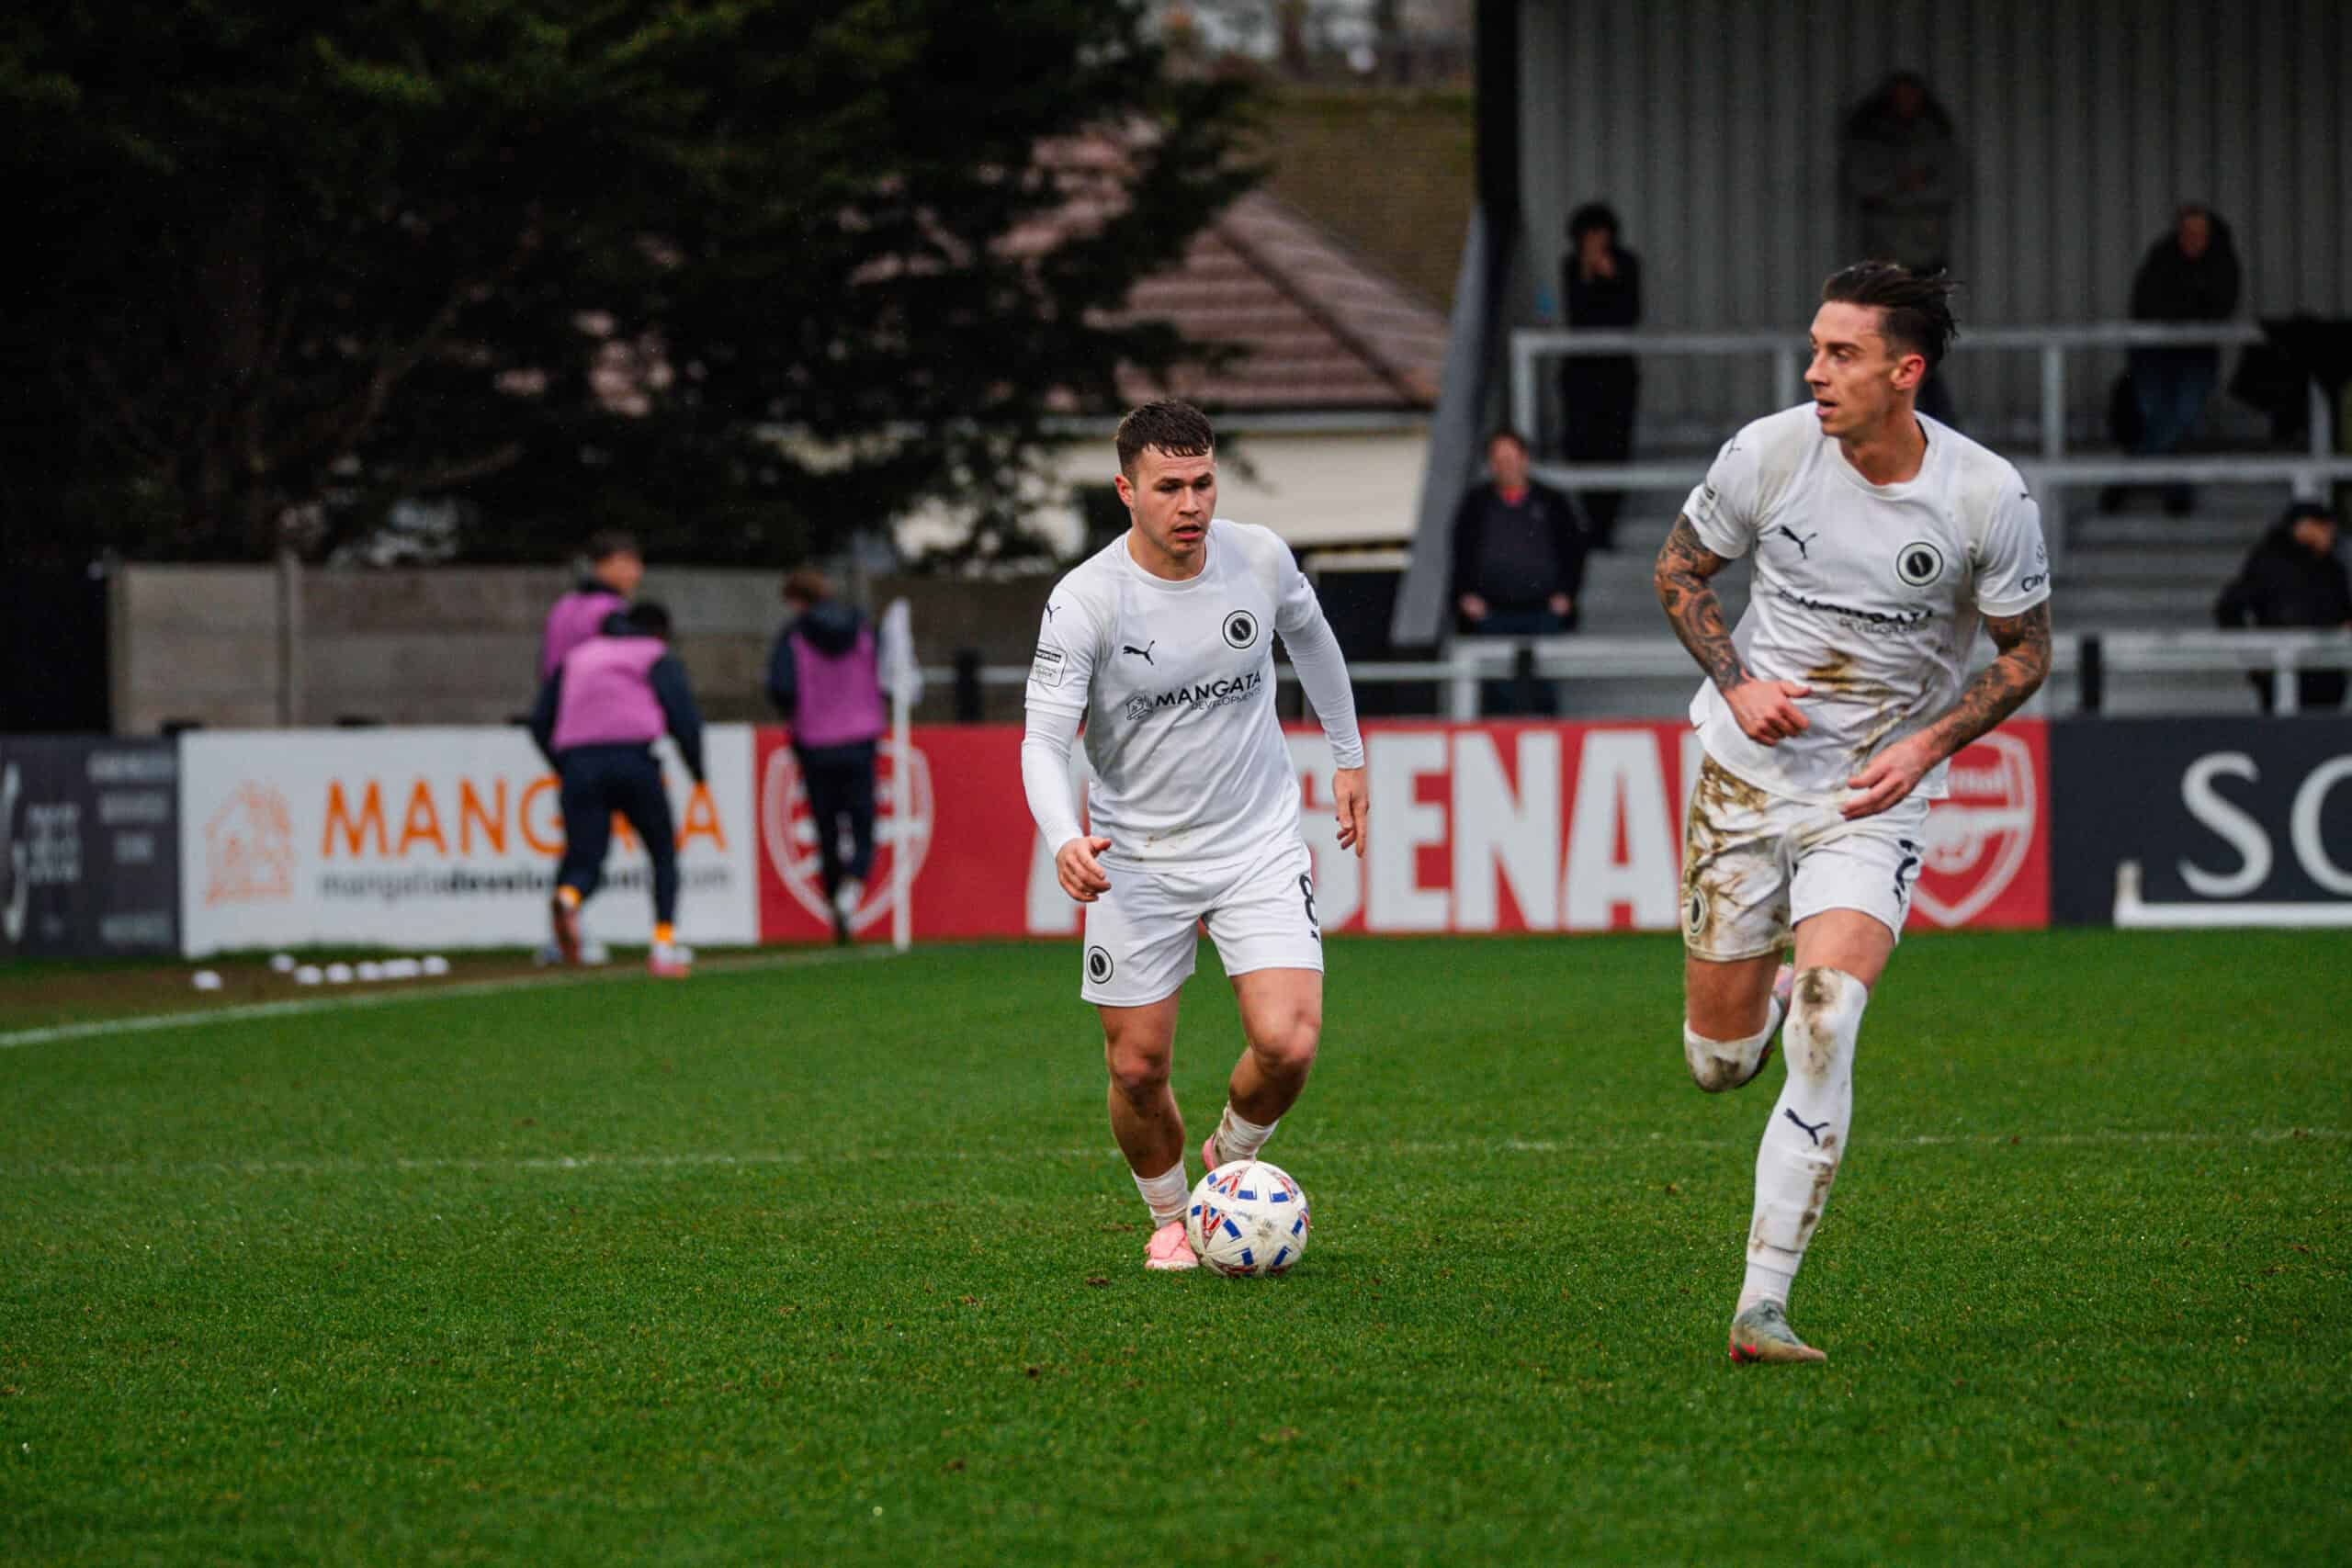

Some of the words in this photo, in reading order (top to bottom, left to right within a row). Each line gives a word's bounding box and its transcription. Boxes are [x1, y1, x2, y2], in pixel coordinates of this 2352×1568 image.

[1156, 671, 1261, 706] MANGATA
[322, 776, 728, 858] MANGA
[1025, 729, 1702, 934] SENA
[1299, 874, 1318, 927] 8
